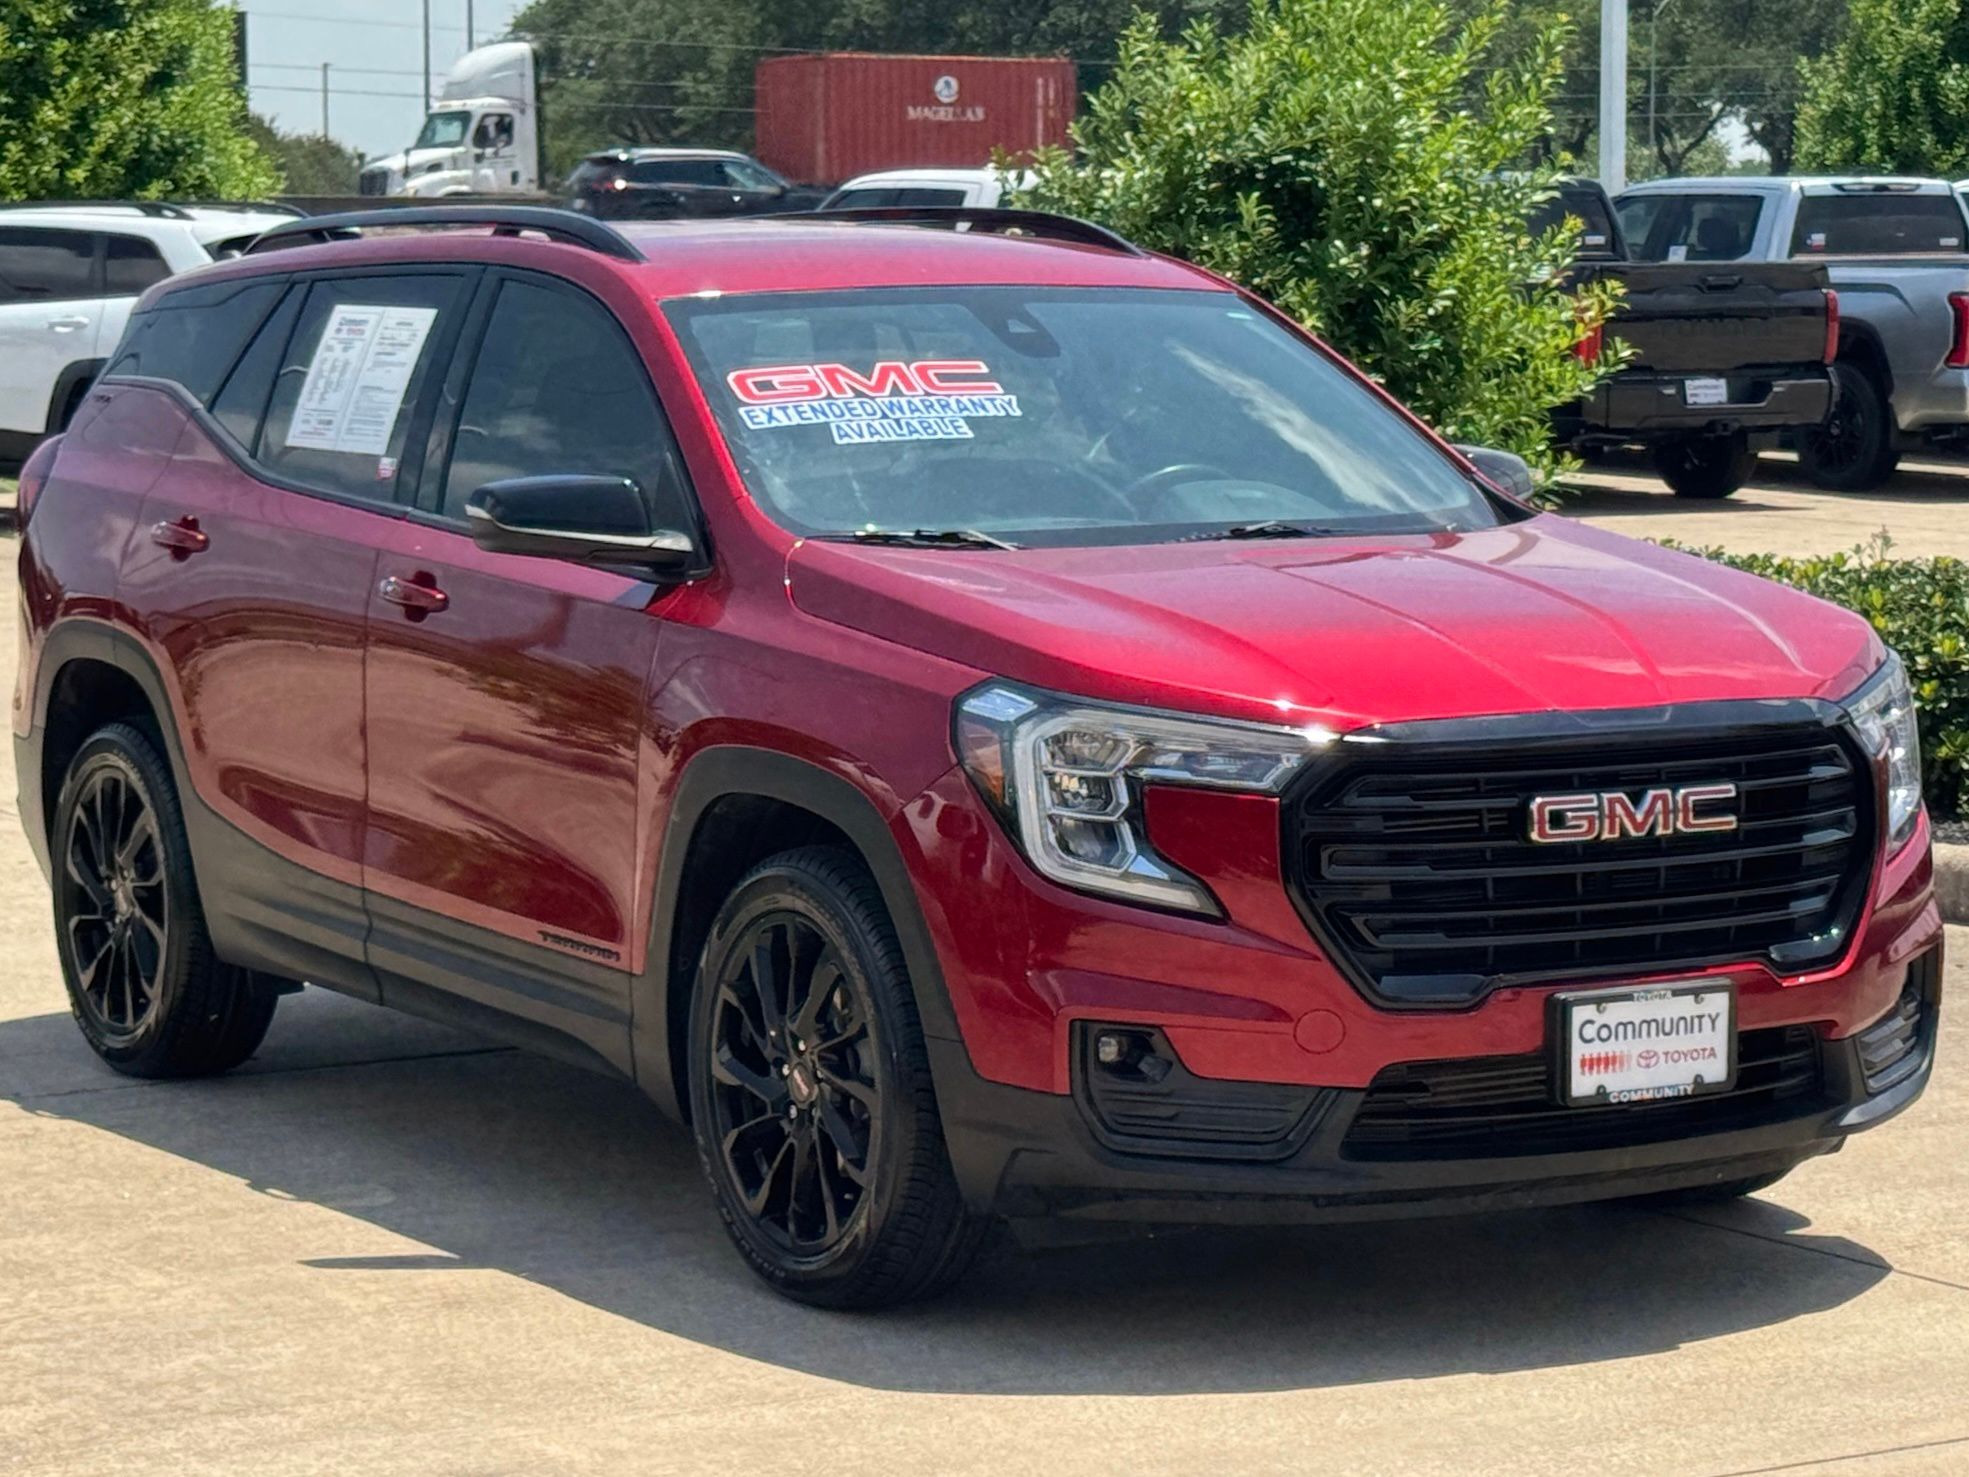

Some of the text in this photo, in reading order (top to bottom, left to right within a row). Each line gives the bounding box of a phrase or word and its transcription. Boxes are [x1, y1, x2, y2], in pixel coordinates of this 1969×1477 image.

[727, 360, 1005, 404] GMC
[742, 396, 1018, 428] EXTENDED WARRANTY
[834, 418, 969, 443] AVAILABLE
[1530, 783, 1738, 843] GMC
[1662, 1047, 1718, 1065] TOYOTA
[1608, 1083, 1696, 1104] COMMUNITY
